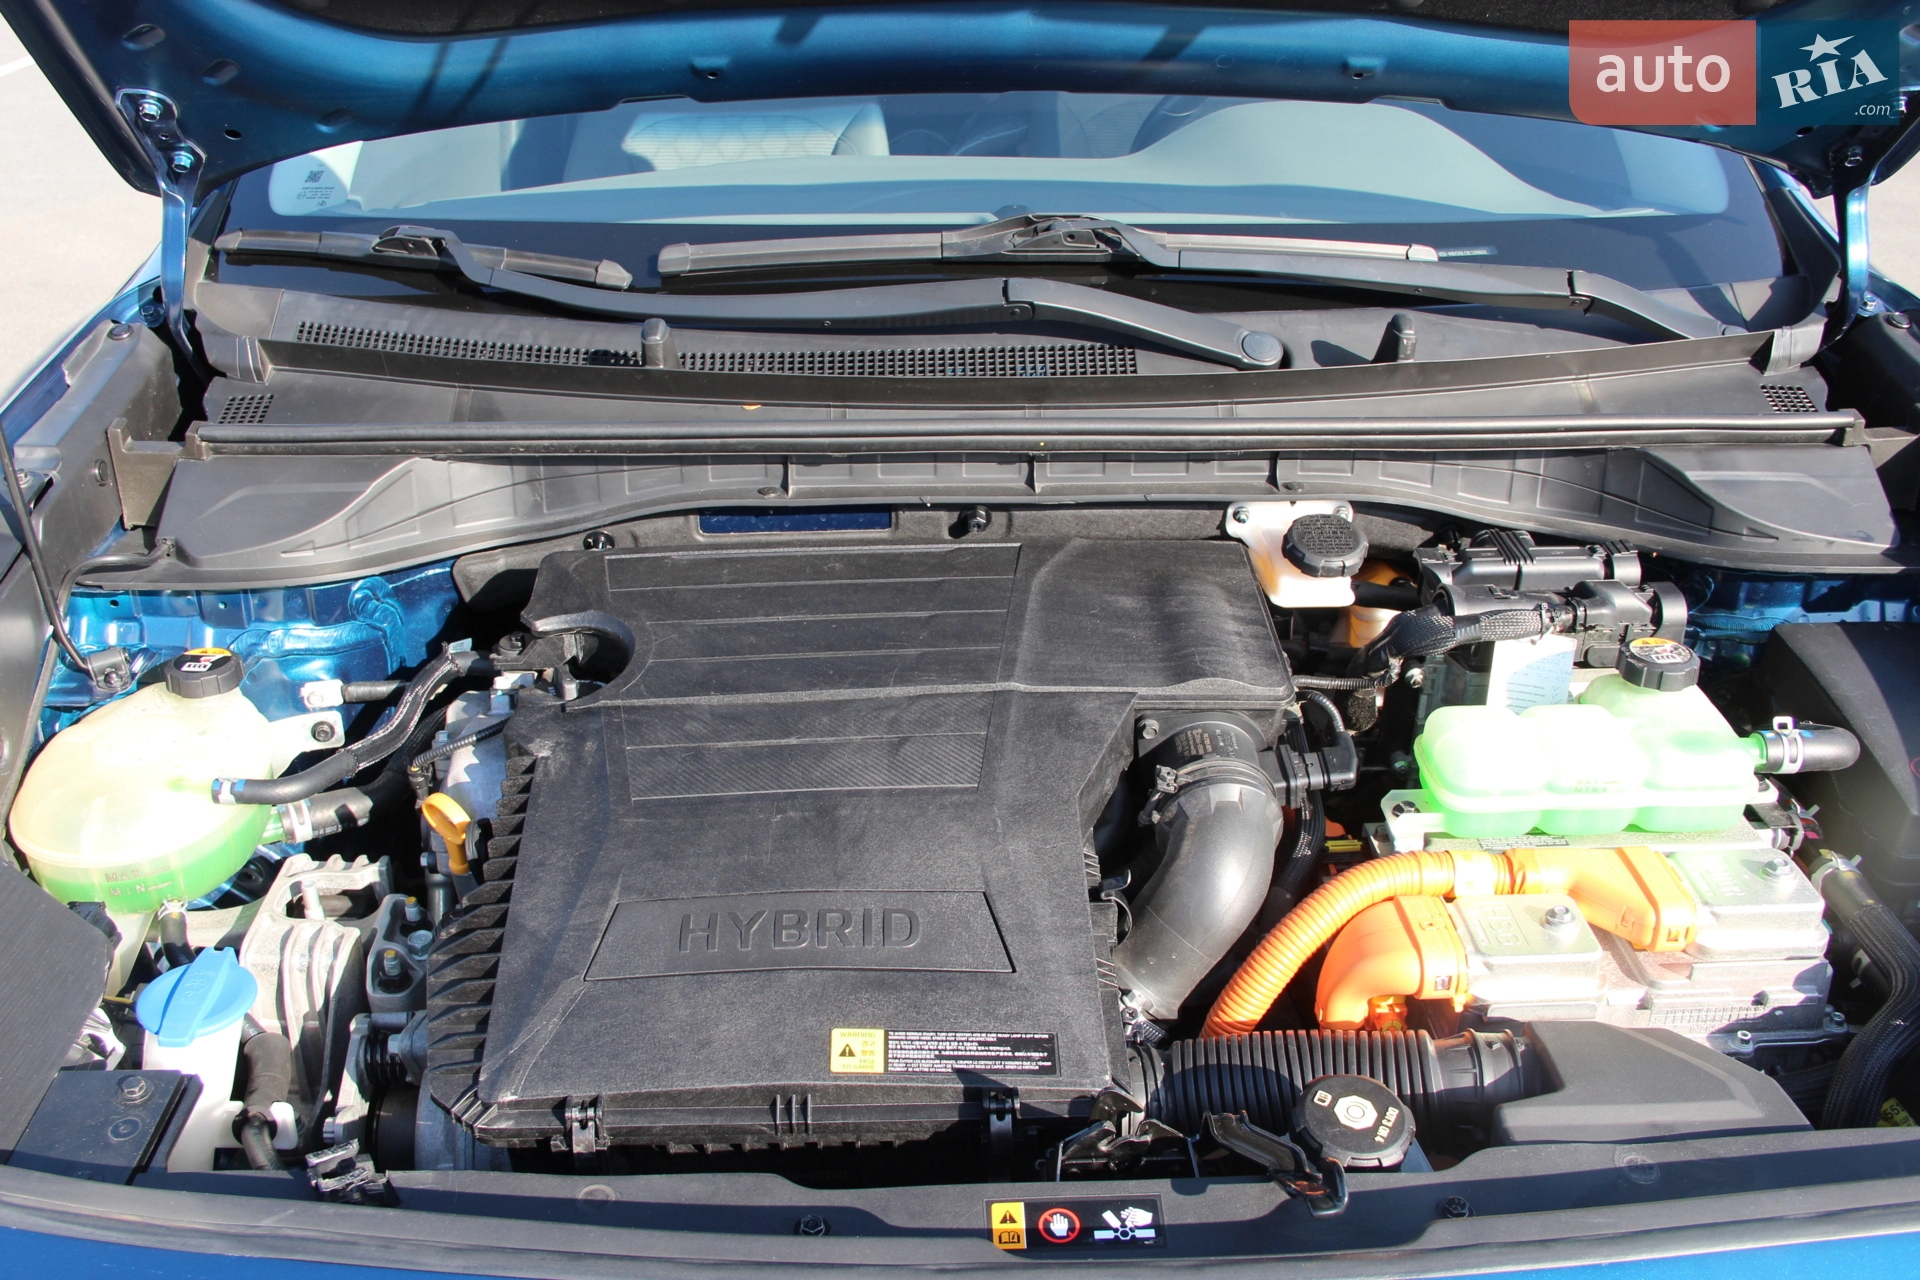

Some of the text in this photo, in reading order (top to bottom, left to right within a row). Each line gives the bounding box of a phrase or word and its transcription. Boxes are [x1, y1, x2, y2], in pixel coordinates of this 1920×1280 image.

[104, 868, 142, 883] MAX
[108, 883, 147, 897] MIN
[678, 907, 922, 953] HYBRID
